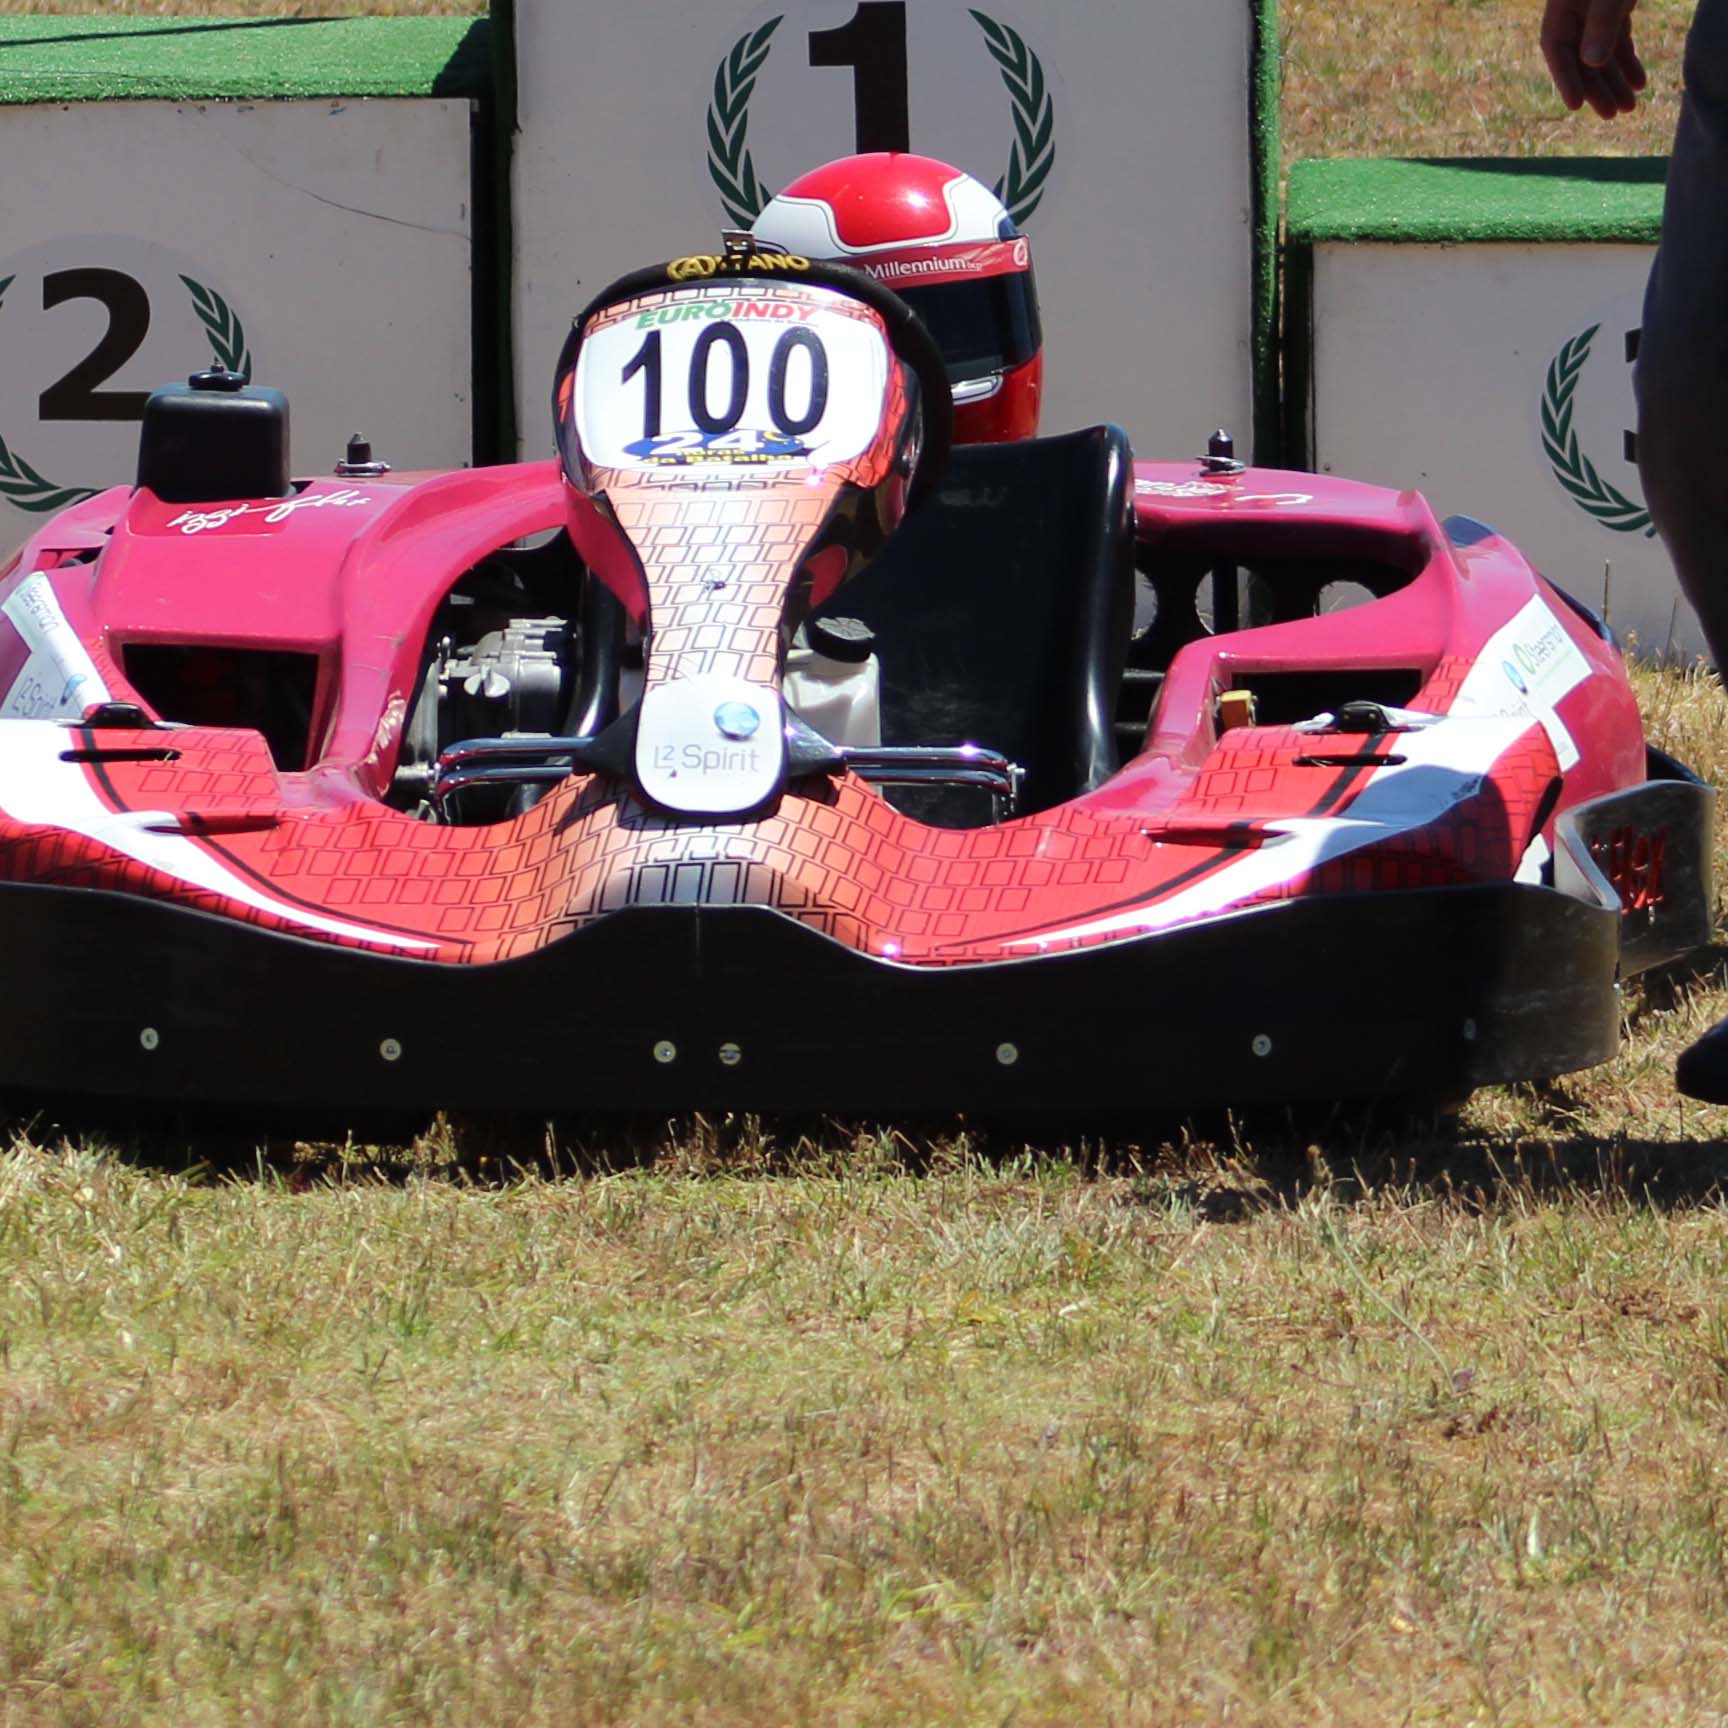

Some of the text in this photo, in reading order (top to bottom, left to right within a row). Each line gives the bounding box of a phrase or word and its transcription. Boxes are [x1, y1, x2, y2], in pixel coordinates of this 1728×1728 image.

[808, 0, 910, 154] 1
[864, 255, 968, 280] Millennium
[39, 267, 156, 421] 2
[635, 300, 819, 331] EUROINDY
[621, 320, 829, 440] 100
[681, 743, 760, 773] Spirit
